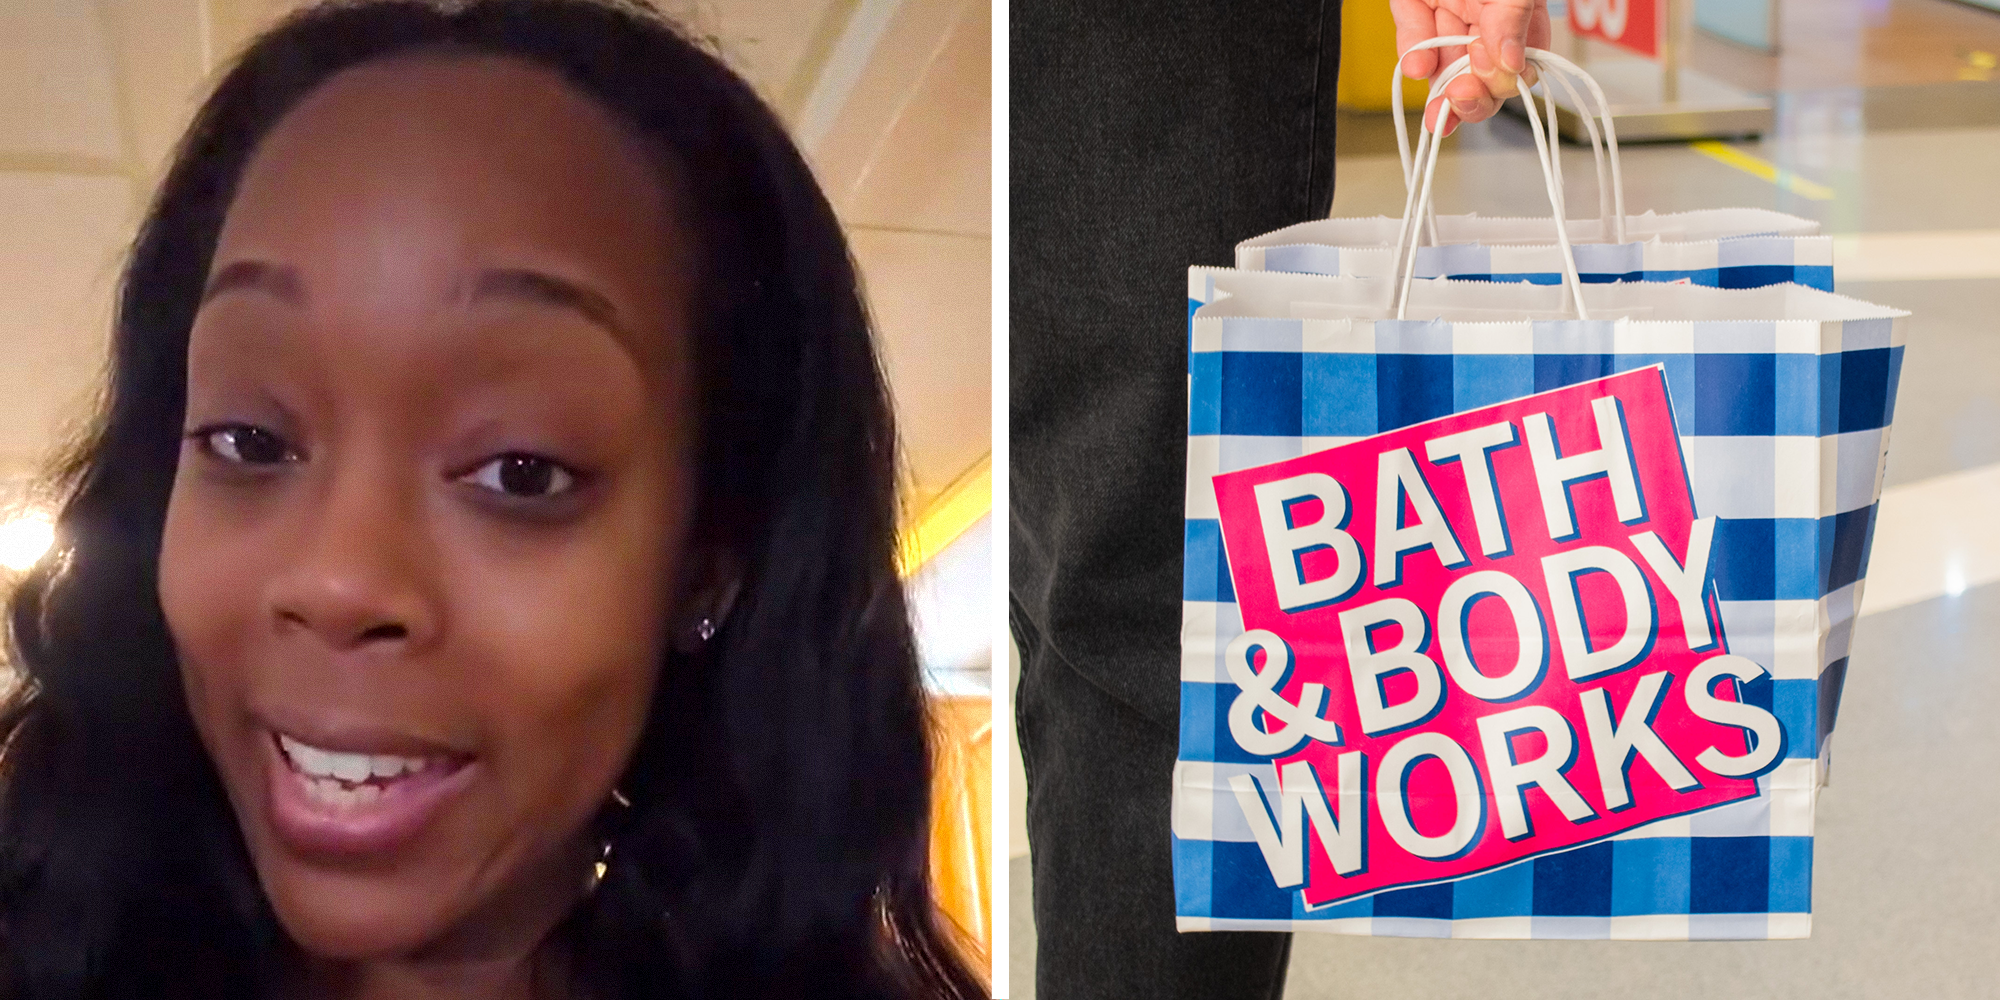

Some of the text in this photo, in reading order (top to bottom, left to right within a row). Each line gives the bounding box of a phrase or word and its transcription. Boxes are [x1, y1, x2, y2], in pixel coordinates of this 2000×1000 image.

[1253, 396, 1648, 611] BATH
[1224, 516, 1719, 757] & BODY
[1228, 654, 1787, 889] WORKS
